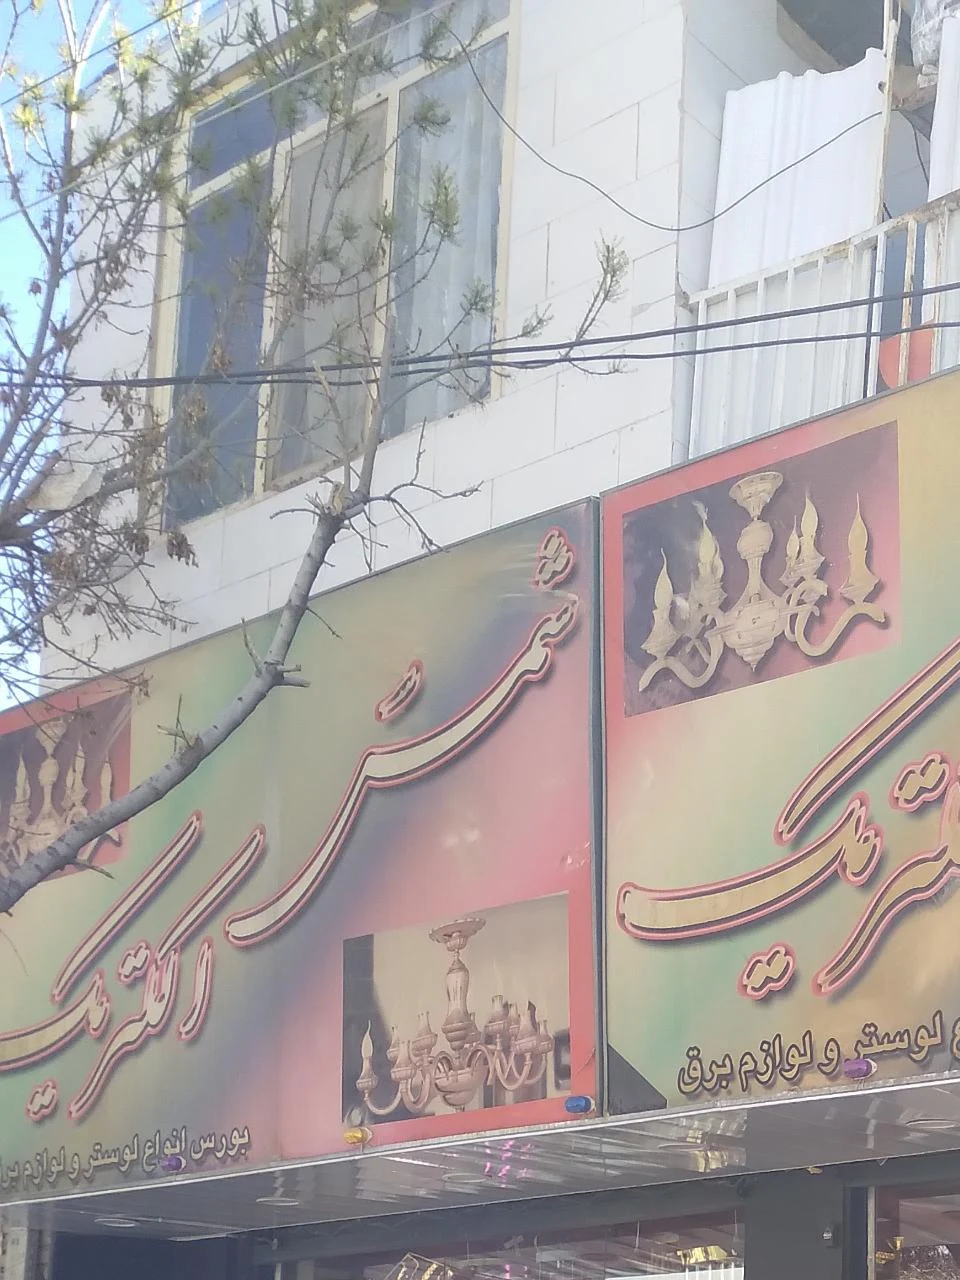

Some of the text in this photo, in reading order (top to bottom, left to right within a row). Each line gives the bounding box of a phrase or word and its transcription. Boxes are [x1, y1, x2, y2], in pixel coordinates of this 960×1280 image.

[225, 527, 579, 948] شمس
[737, 1030, 814, 1090] لوازم
[817, 1036, 841, 1076] و
[849, 1010, 943, 1067] لوستر
[677, 1046, 734, 1097] برق
[0, 1126, 250, 1189] بورس انواع لوستر و لوازم بر
